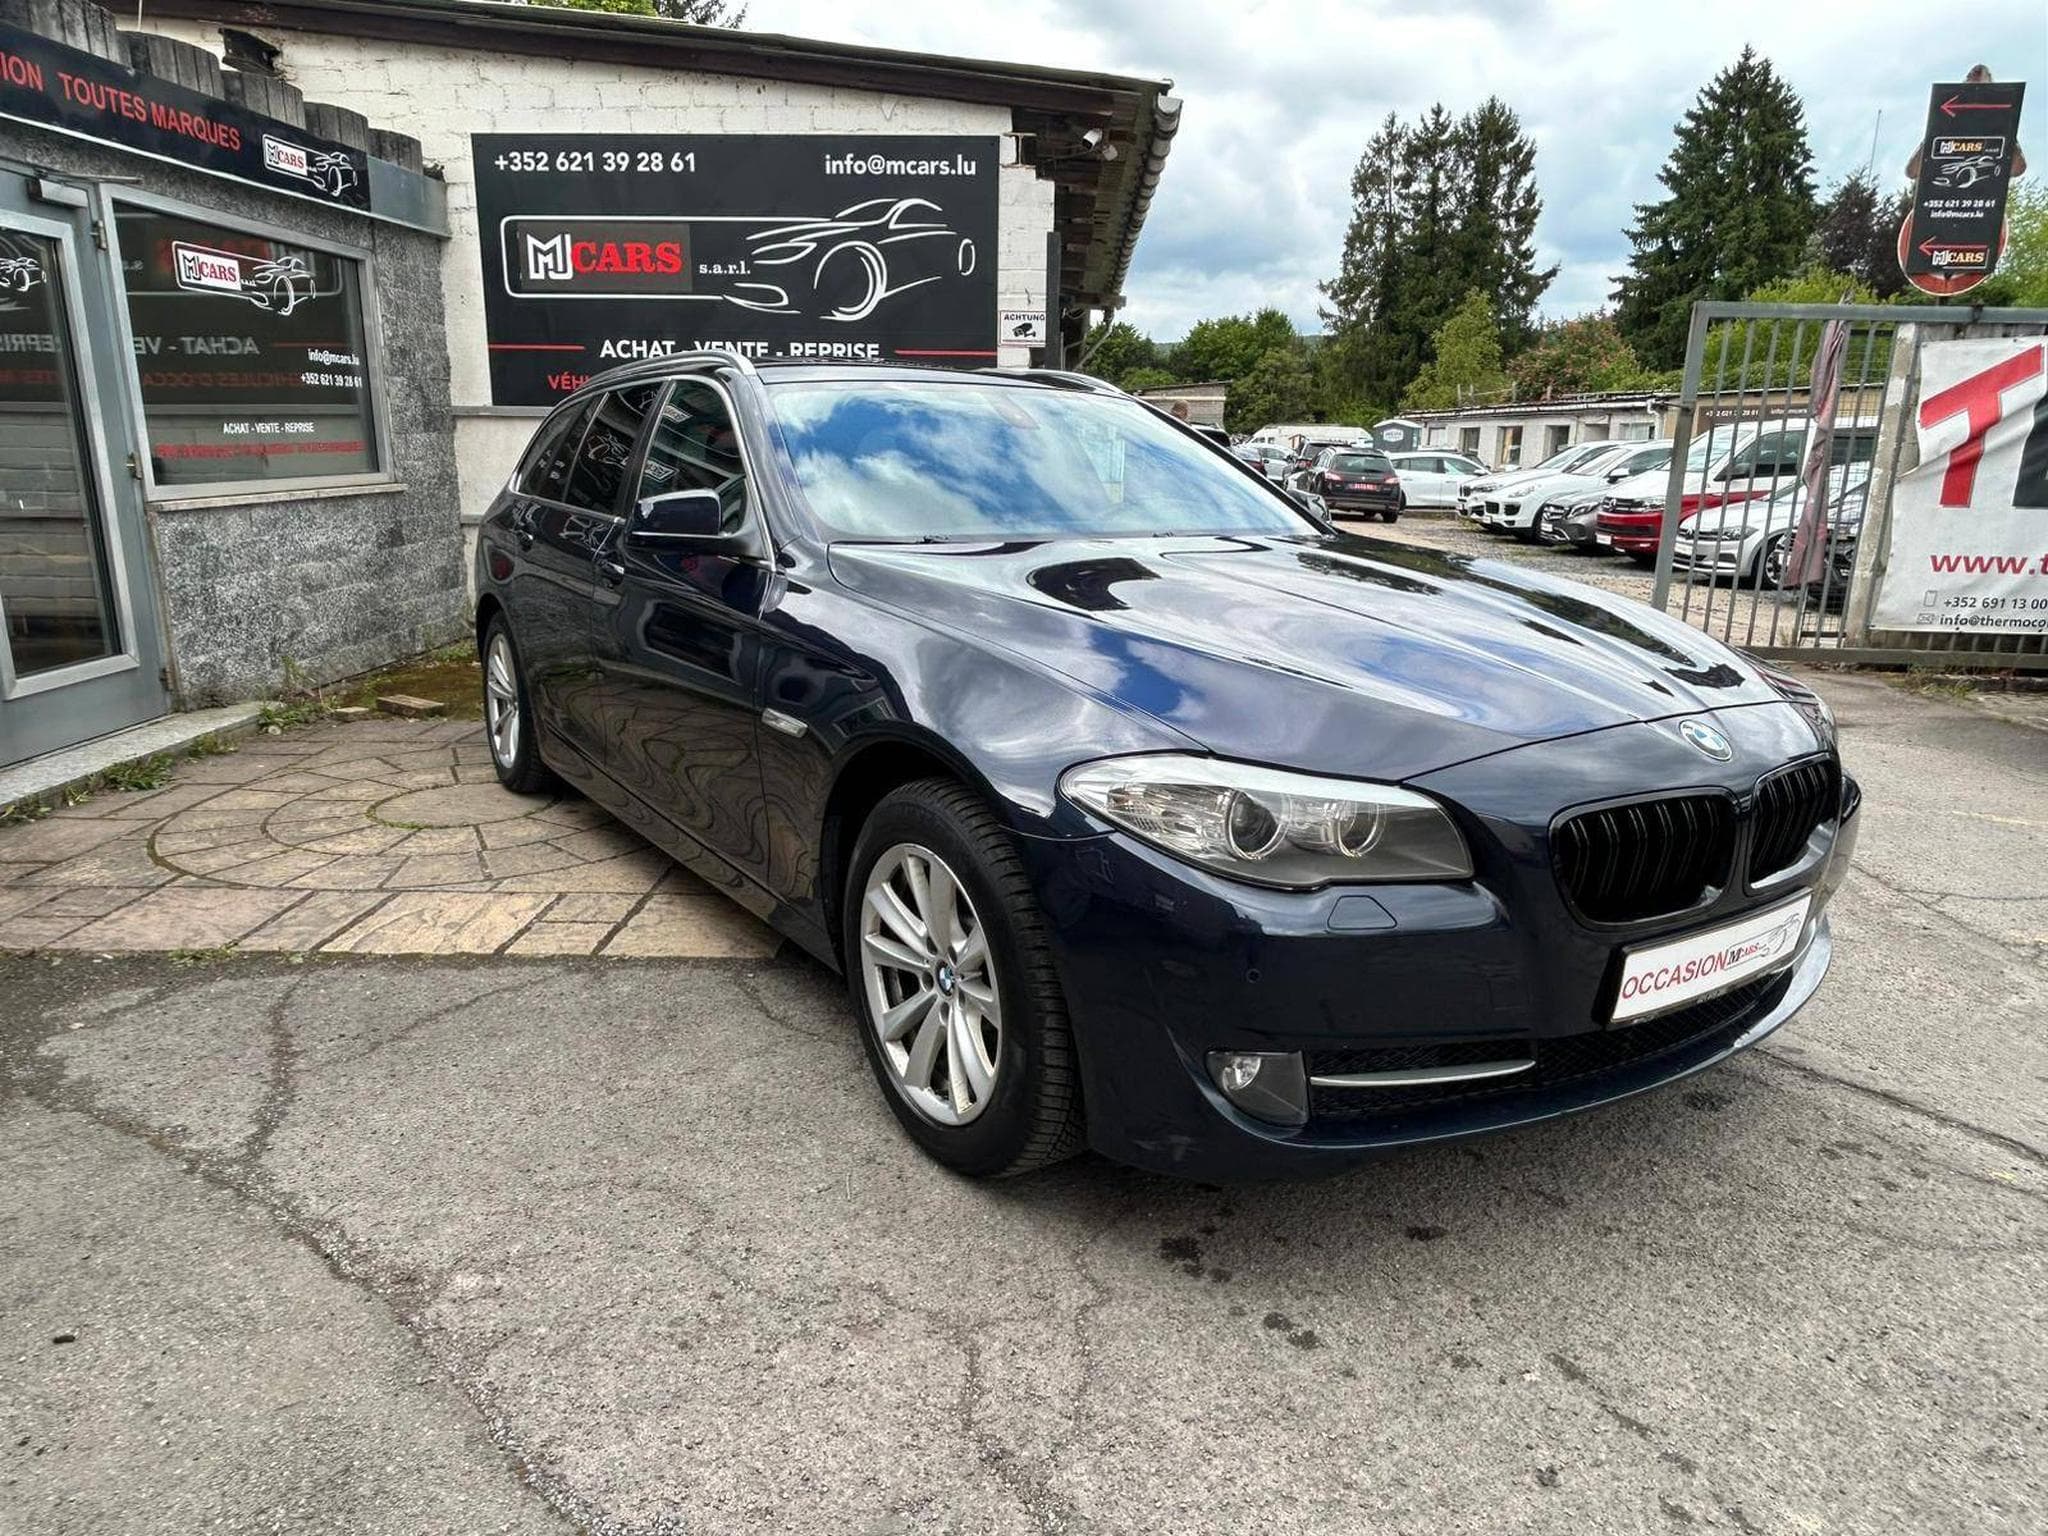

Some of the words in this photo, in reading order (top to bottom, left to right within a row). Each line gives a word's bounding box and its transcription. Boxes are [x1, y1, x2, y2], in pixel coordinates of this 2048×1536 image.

[57, 71, 147, 122] TOUTES
[150, 101, 240, 151] MARQUES
[495, 152, 549, 172] +352
[556, 152, 594, 172] 621
[602, 152, 629, 172] 39
[636, 152, 663, 172] 28
[670, 152, 695, 173] 61
[825, 154, 977, 176] info@mcars.lu
[699, 260, 751, 274] s.a.r.l.
[308, 348, 360, 366] info@mcars.lu
[600, 339, 676, 359] ACHAT
[694, 341, 769, 358] VENTE
[790, 342, 880, 358] REPRISE
[301, 372, 320, 385] +352
[320, 373, 333, 386] 621
[354, 376, 363, 388] 61
[223, 422, 250, 434] ACHAT
[255, 422, 280, 434] VENTE
[284, 422, 315, 433] REPRISE
[1943, 597, 1977, 608] +352
[1982, 597, 2006, 609] 691
[2012, 598, 2026, 609] 13
[1622, 949, 1729, 999] OCCASION
